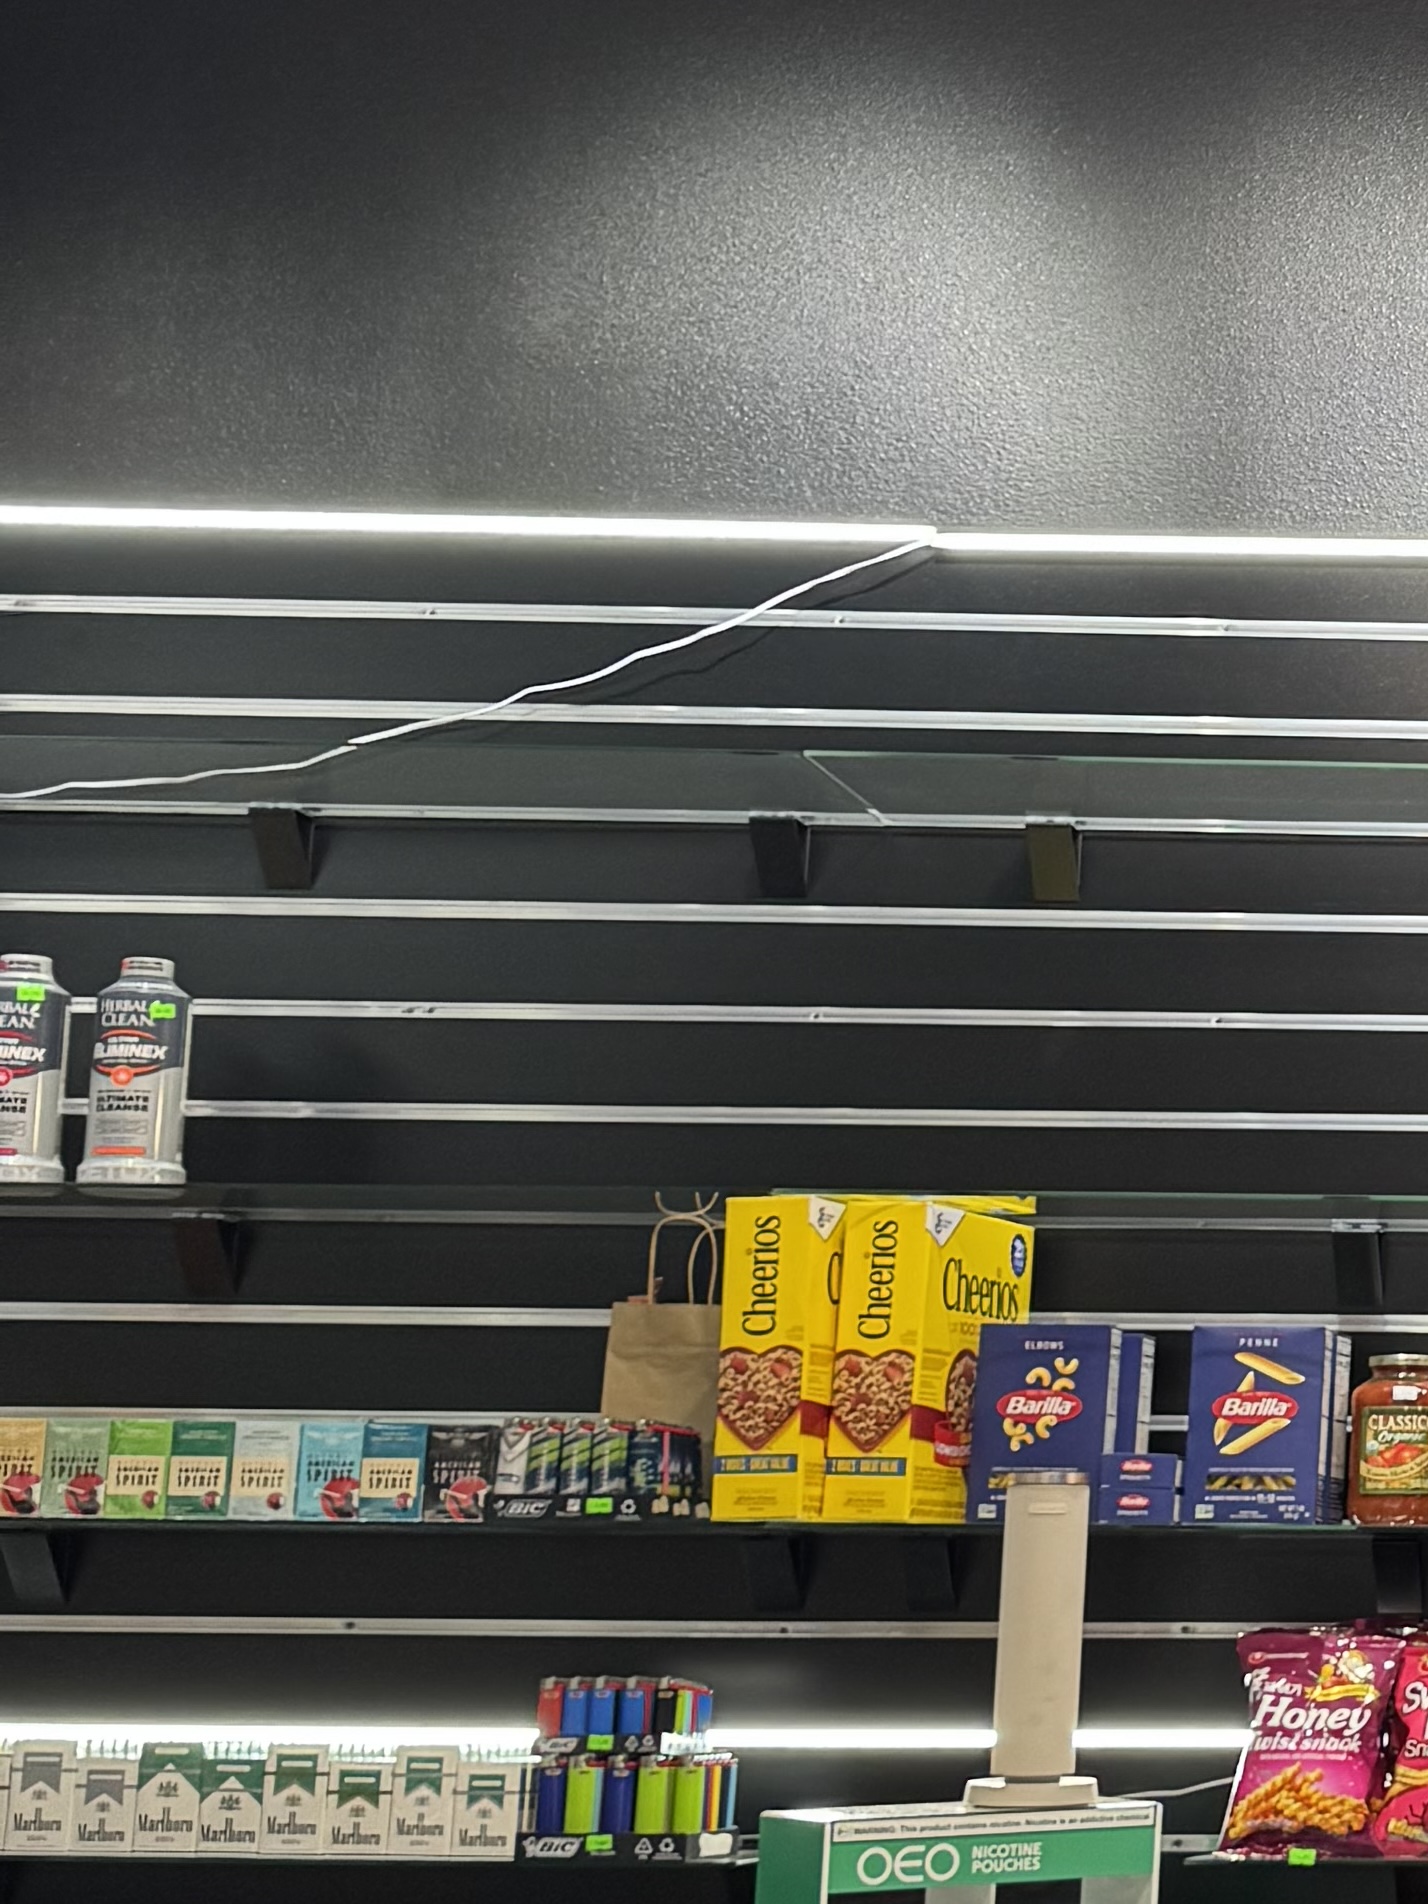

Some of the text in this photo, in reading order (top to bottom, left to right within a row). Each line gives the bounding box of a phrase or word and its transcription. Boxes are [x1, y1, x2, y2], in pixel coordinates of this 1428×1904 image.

[102, 1014, 155, 1028] CLEAN
[742, 1215, 781, 1336] Cheerios
[857, 1220, 899, 1339] Cheerios
[943, 1258, 1019, 1323] Cheerios
[1024, 1340, 1064, 1351] ELBOWS
[1238, 1337, 1279, 1348] PENNE
[1006, 1396, 1076, 1415] Barilla
[1221, 1396, 1295, 1418] Barilla
[1377, 1430, 1425, 1444] Organic
[1255, 1699, 1371, 1734] Honey
[13, 1807, 62, 1832] Marlboro
[78, 1818, 126, 1842] Marlboro
[139, 1806, 194, 1834] Marlboro
[202, 1818, 255, 1845] Marlboro
[538, 1839, 578, 1857] BIC
[972, 1842, 1042, 1858] NICOTINE
[857, 1843, 960, 1886] OEO
[972, 1857, 1040, 1873] POUCHES
